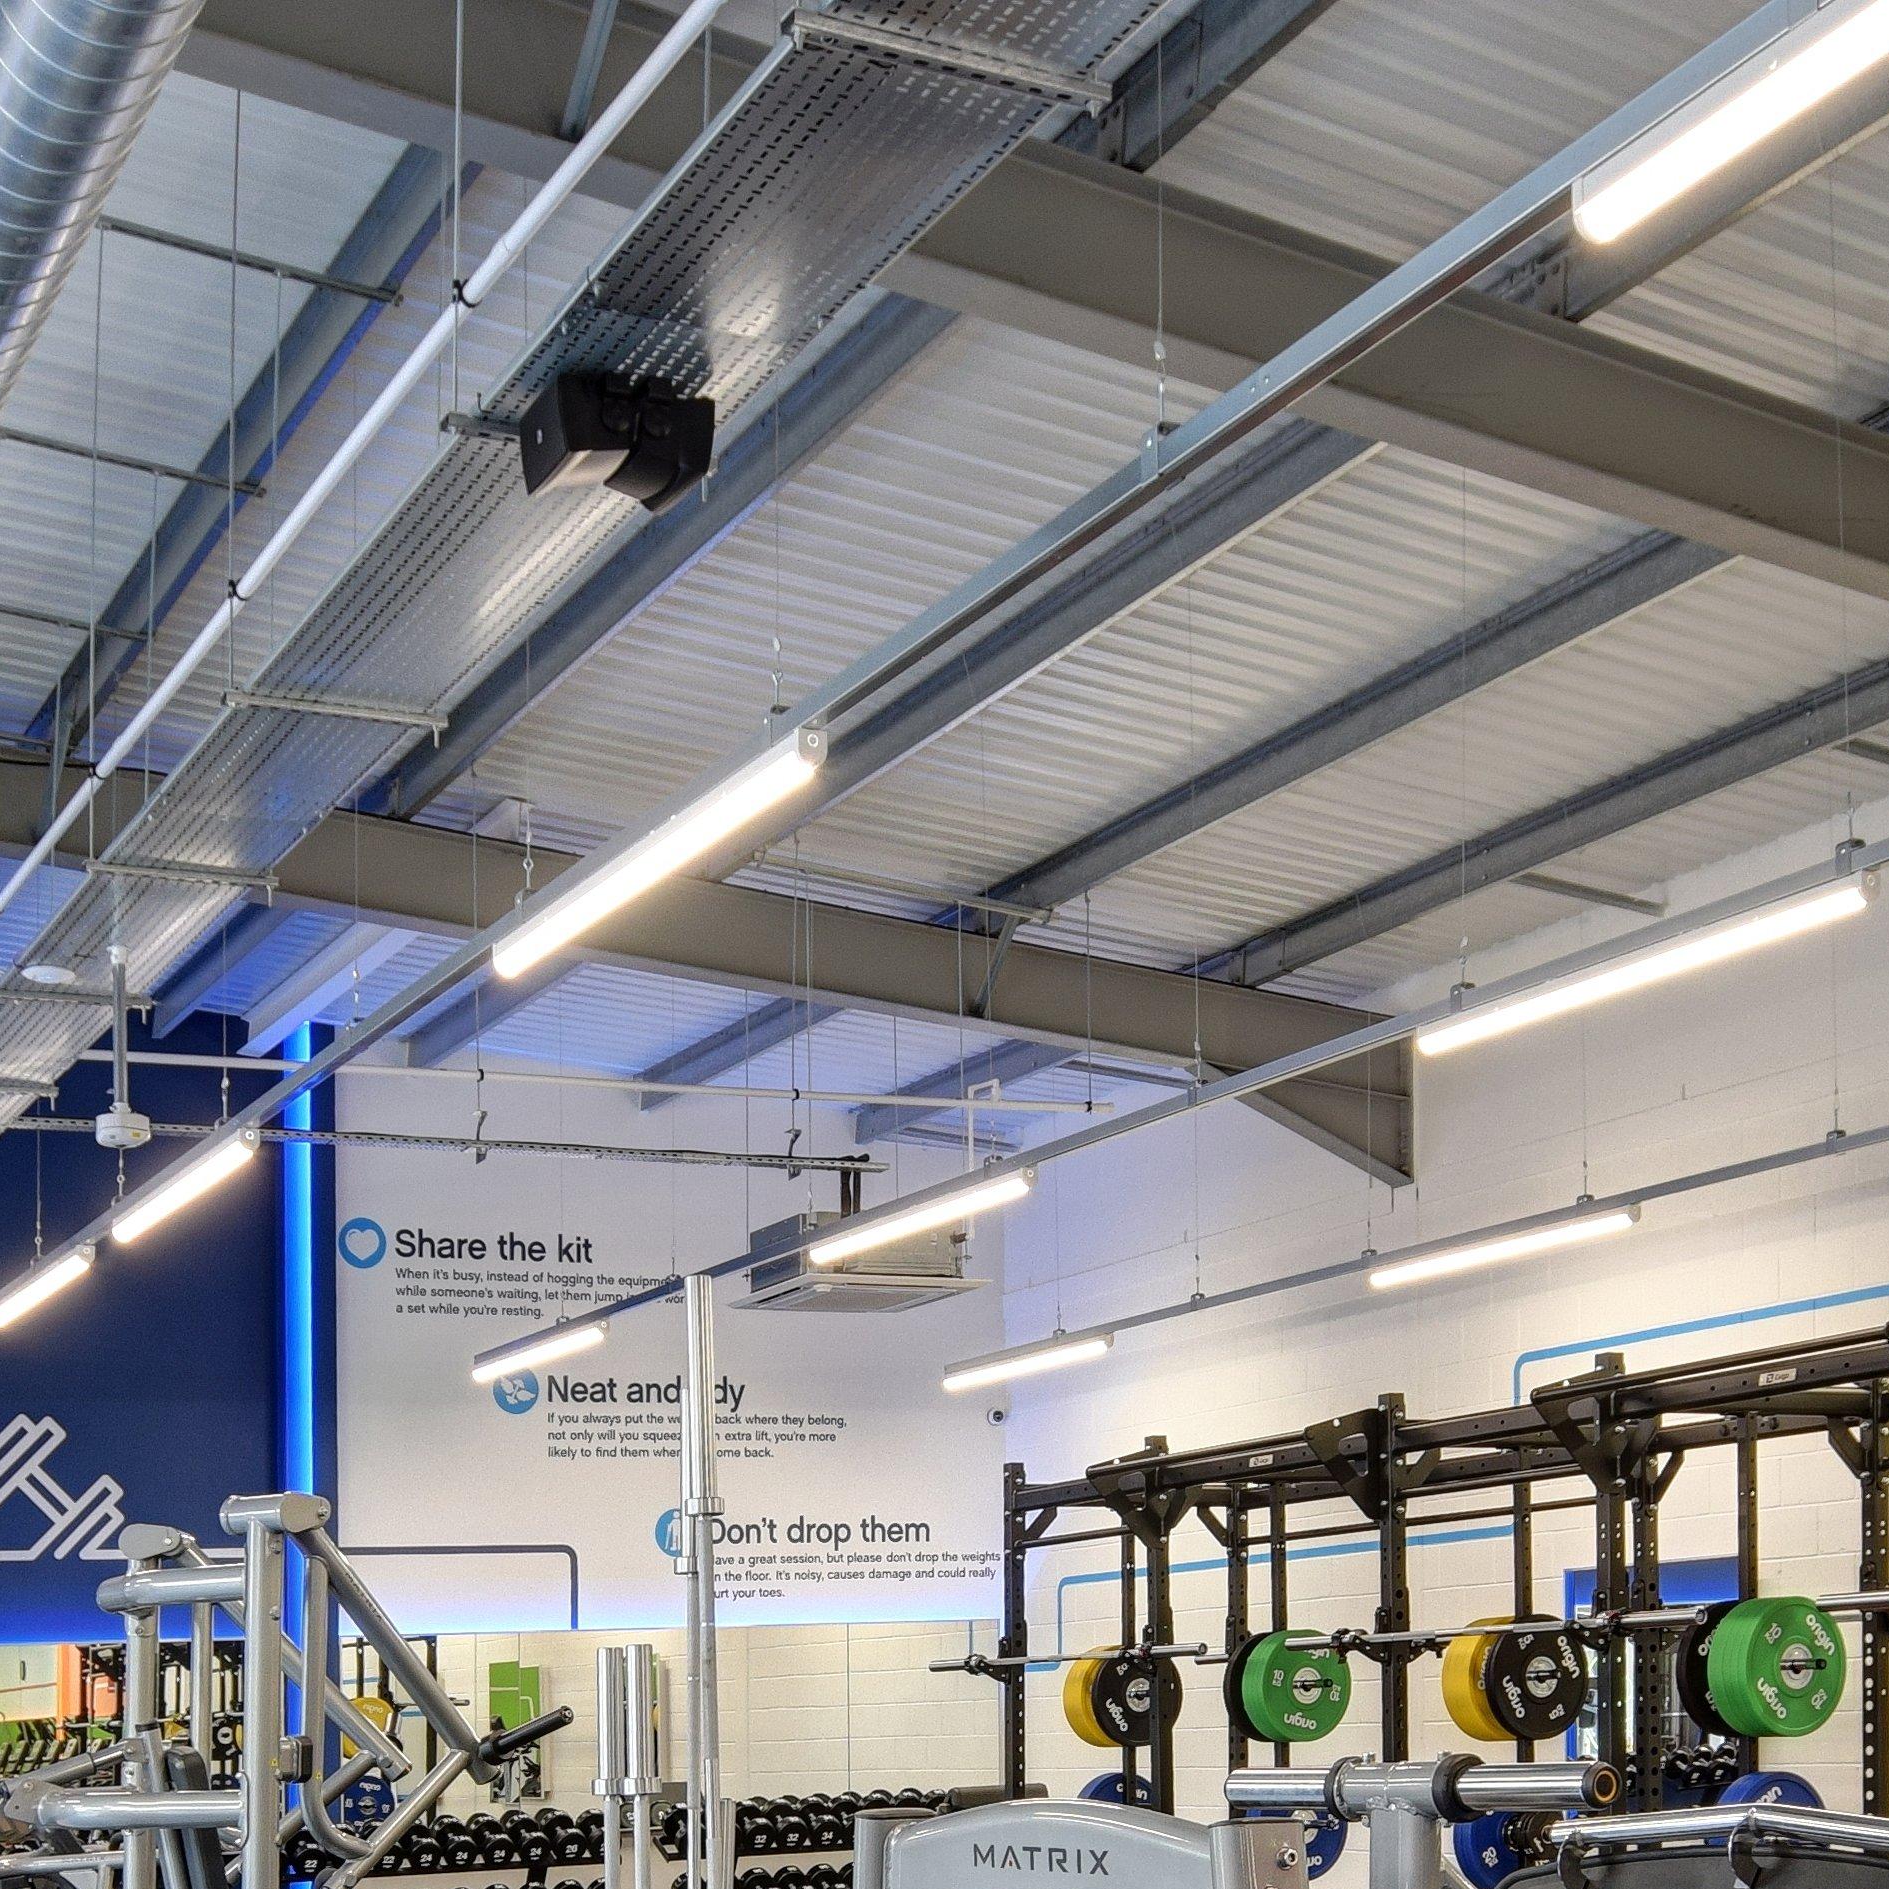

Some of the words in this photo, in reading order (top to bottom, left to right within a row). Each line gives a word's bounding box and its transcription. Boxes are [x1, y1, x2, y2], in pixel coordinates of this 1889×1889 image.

[394, 1228, 487, 1260] Share
[497, 1231, 546, 1262] the
[558, 1233, 593, 1264] kit
[395, 1267, 429, 1280] When
[433, 1269, 449, 1280] it's
[452, 1269, 483, 1284] busy,
[486, 1270, 529, 1282] instead
[532, 1272, 544, 1283] of
[547, 1272, 593, 1287] hogging
[597, 1273, 614, 1285] the
[618, 1275, 668, 1289] equipm
[395, 1285, 427, 1296] while
[430, 1287, 494, 1298] someone's
[497, 1288, 541, 1303] waiting,
[544, 1289, 558, 1301] let
[561, 1290, 591, 1302] them
[594, 1290, 623, 1304] jump
[395, 1304, 403, 1313] a
[407, 1303, 425, 1314] set
[429, 1303, 460, 1315] while
[463, 1304, 498, 1318] you're
[501, 1306, 543, 1320] resting.
[547, 1375, 618, 1403] Neat
[626, 1375, 681, 1403] and
[714, 1375, 746, 1413] dy
[547, 1412, 555, 1423] If
[558, 1414, 579, 1426] you
[582, 1412, 622, 1426] always
[625, 1414, 643, 1426] put
[646, 1412, 664, 1424] the
[745, 1414, 778, 1425] where
[781, 1413, 804, 1428] they
[808, 1413, 848, 1429] belong,
[547, 1430, 566, 1441] not
[570, 1429, 594, 1443] only
[597, 1429, 616, 1441] will
[619, 1431, 639, 1443] you
[642, 1432, 682, 1443] squeez
[724, 1431, 752, 1442] extra
[755, 1430, 772, 1443] lift,
[774, 1430, 806, 1444] you're
[808, 1432, 837, 1442] more
[547, 1446, 577, 1460] likely
[580, 1446, 591, 1458] to
[595, 1446, 617, 1458] find
[620, 1446, 650, 1458] them
[716, 1448, 741, 1458] ome
[744, 1446, 774, 1458] back.
[711, 1516, 778, 1545] Don't
[787, 1515, 851, 1551] drop
[860, 1514, 930, 1543] them
[714, 1556, 735, 1566] ave
[738, 1555, 745, 1564] a
[748, 1554, 776, 1567] great
[780, 1552, 824, 1566] session,
[826, 1552, 843, 1564] but
[846, 1551, 882, 1565] please
[886, 1551, 911, 1563] don't
[914, 1550, 939, 1565] drop
[941, 1550, 958, 1562] the
[961, 1550, 1001, 1564] weights
[724, 1571, 742, 1582] the
[745, 1570, 772, 1582] floor.
[775, 1570, 791, 1581] It's
[794, 1570, 824, 1583] noisy,
[828, 1569, 865, 1580] causes
[868, 1568, 912, 1582] damage
[914, 1567, 935, 1579] and
[937, 1566, 966, 1578] could
[968, 1566, 996, 1580] really
[714, 1589, 730, 1599] urt
[732, 1589, 756, 1601] your
[758, 1587, 785, 1598] toes.
[1805, 1613, 1836, 1656] origin
[1557, 1635, 1581, 1679] origin
[1502, 1674, 1526, 1719] origin
[1757, 1677, 1787, 1720] origin
[1105, 1698, 1129, 1733] origin
[1283, 1712, 1317, 1731] origin
[972, 1843, 1110, 1877] MATRIX
[1482, 1846, 1498, 1861] 20
